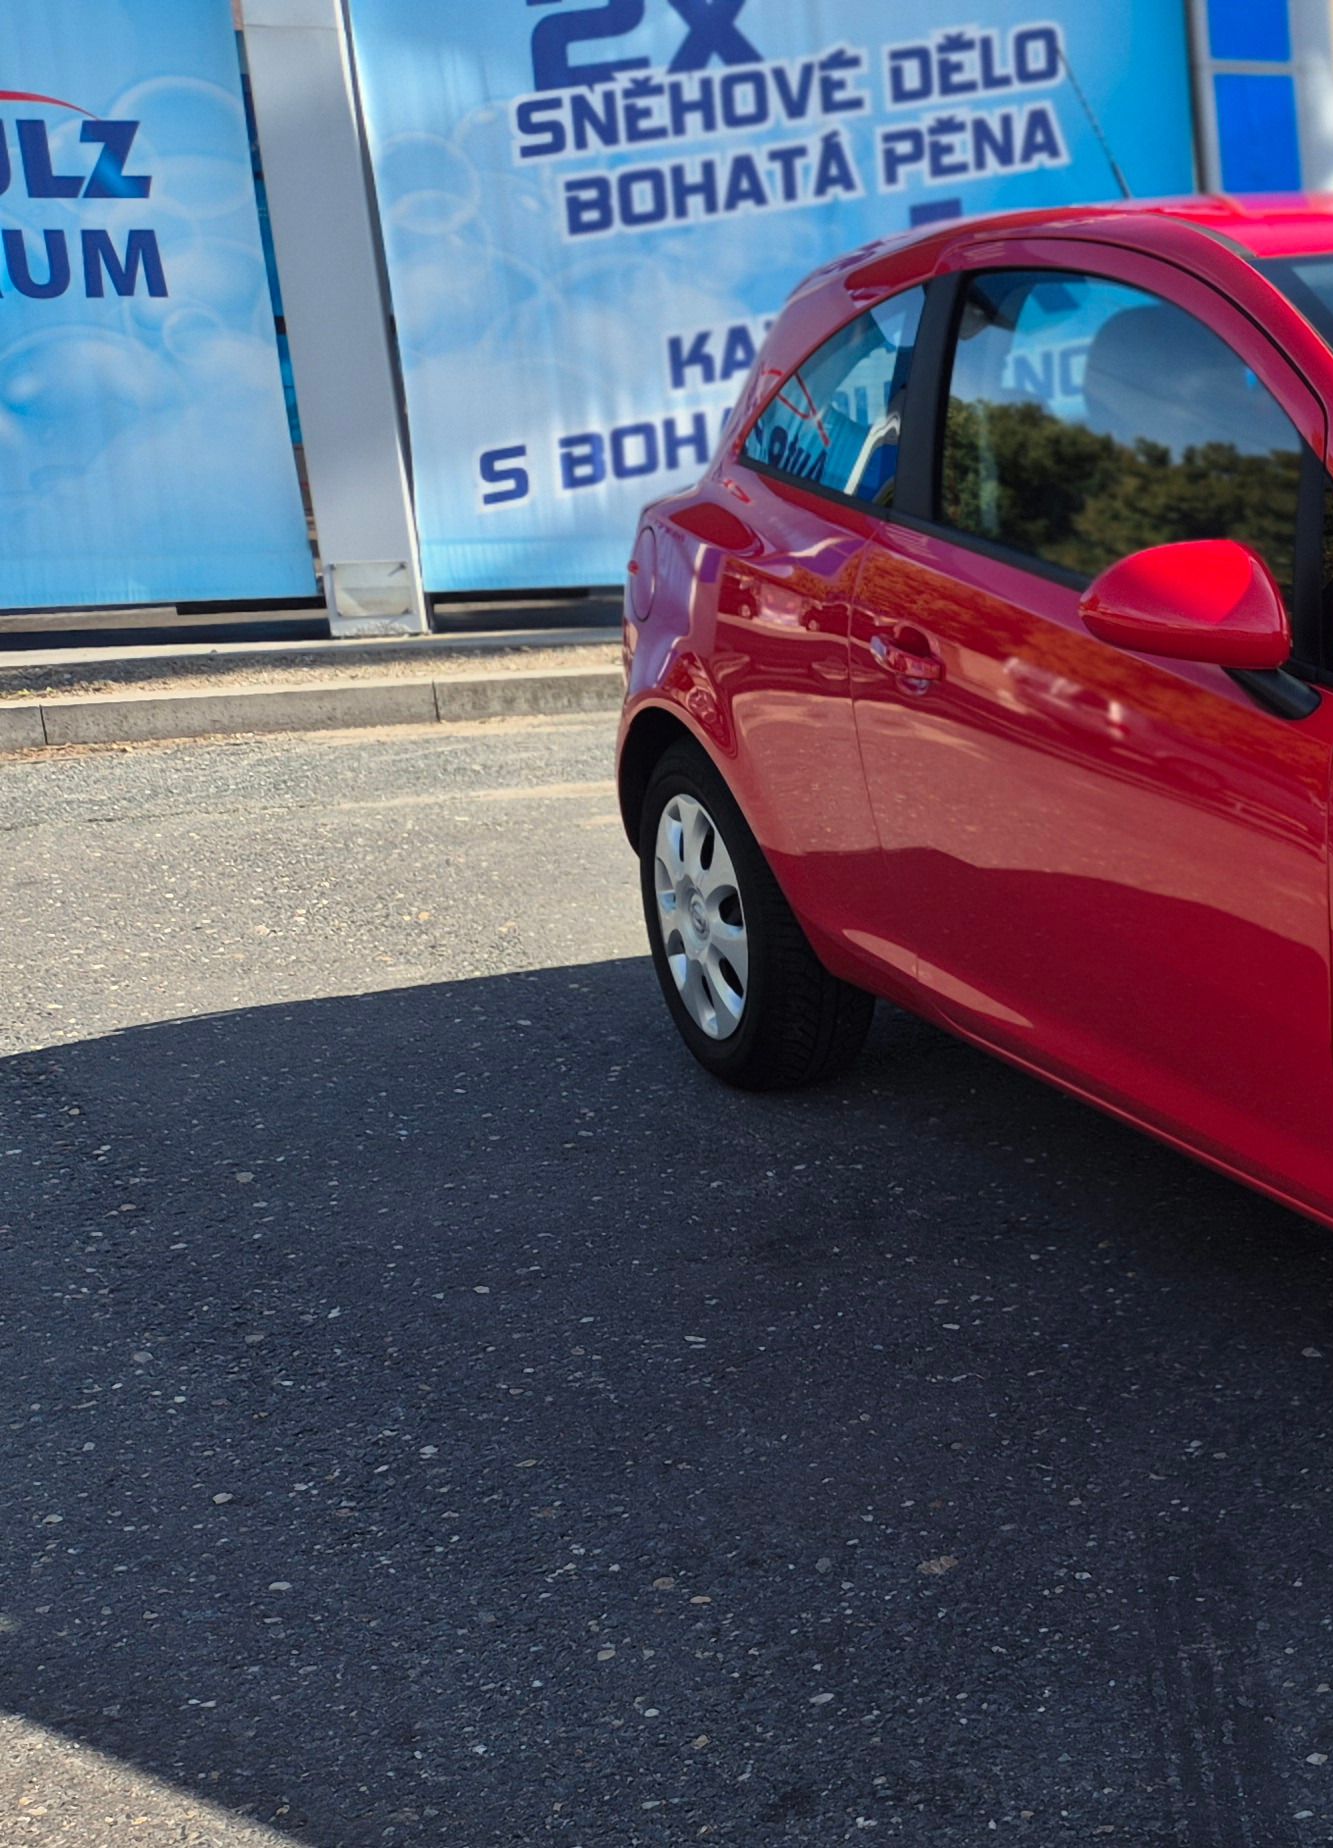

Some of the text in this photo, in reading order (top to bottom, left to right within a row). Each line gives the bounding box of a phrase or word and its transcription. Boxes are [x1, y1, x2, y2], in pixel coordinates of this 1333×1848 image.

[516, 27, 1059, 159] SNĚHOVÉ DĚLO
[564, 107, 1061, 236] BOHATÁ PĚNA
[0, 229, 168, 299] UM
[667, 318, 776, 390] KA
[479, 444, 529, 505] S
[558, 407, 733, 490] BOH
